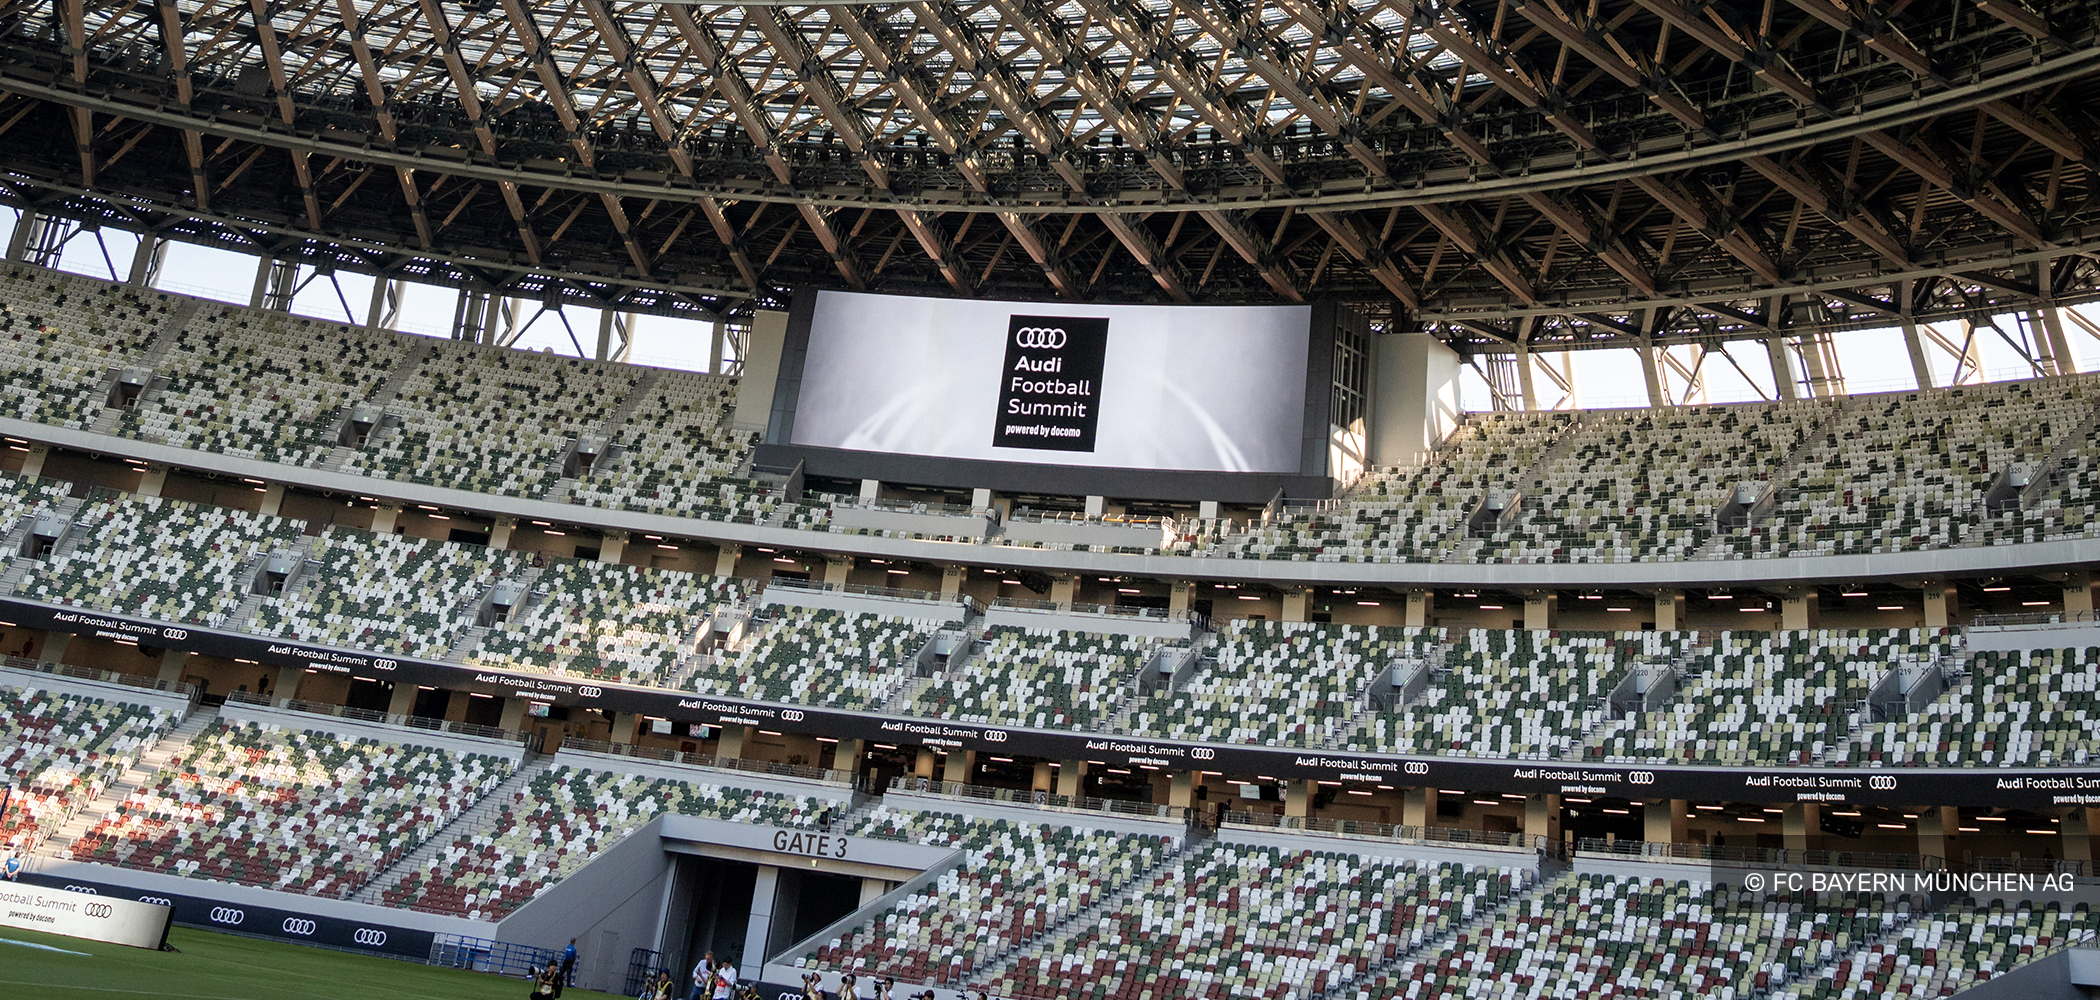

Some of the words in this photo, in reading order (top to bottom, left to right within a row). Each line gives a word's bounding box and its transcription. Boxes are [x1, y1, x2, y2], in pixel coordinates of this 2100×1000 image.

[1014, 356, 1062, 372] Audi
[1011, 377, 1091, 396] Football
[1007, 398, 1087, 417] Summit
[1005, 425, 1039, 435] powered
[1040, 425, 1050, 437] by
[1051, 426, 1081, 437] docomo
[271, 552, 282, 560] 226
[1928, 592, 1940, 600] 219
[2070, 586, 2082, 594] 218
[54, 612, 77, 622] Audi
[79, 616, 117, 629] Football
[119, 622, 158, 635] Summit
[96, 630, 116, 638] powered
[116, 632, 121, 640] by
[122, 634, 139, 642] docomo
[268, 644, 290, 654] Audi
[292, 648, 329, 660] Football
[331, 653, 368, 666] Summit
[309, 662, 328, 670] powered
[334, 665, 350, 673] docomo
[1900, 668, 1912, 676] 219
[475, 673, 497, 683] Audi
[499, 676, 535, 689] Football
[537, 681, 572, 694] Summit
[516, 690, 534, 698] powered
[679, 699, 700, 708] Audi
[702, 702, 738, 714] Football
[740, 706, 775, 717] Summit
[719, 715, 736, 724] powered
[737, 717, 742, 725] by
[743, 718, 759, 726] docomo
[881, 721, 903, 730] Audi
[905, 723, 941, 735] Football
[942, 727, 978, 738] Summit
[923, 737, 940, 745] powered
[941, 738, 946, 746] by
[946, 739, 962, 747] docomo
[1086, 740, 1108, 750] Audi
[1110, 742, 1147, 754] Football
[1148, 746, 1185, 756] Summit
[1129, 756, 1147, 764] powered
[1147, 757, 1152, 765] by
[1153, 758, 1169, 766] docomo
[1295, 756, 1318, 766] Audi
[1320, 758, 1358, 769] Football
[1360, 761, 1398, 772] Summit
[1366, 774, 1382, 782] docomo
[1514, 769, 1537, 779] Audi
[1539, 769, 1580, 781] Football
[1582, 771, 1622, 782] Summit
[1746, 776, 1770, 786] Audi
[1773, 776, 1816, 788] Football
[1819, 777, 1862, 788] Summit
[1996, 778, 2023, 789] Audi
[2026, 778, 2074, 789] Football
[2076, 777, 2100, 789] Sum
[1561, 785, 1581, 793] powered
[1581, 786, 1587, 794] by
[1588, 786, 1606, 794] docomo
[1797, 792, 1818, 801] powered
[1819, 792, 1825, 802] by
[1826, 793, 1845, 801] docomo
[2053, 794, 2076, 804] powered
[2077, 794, 2084, 804] by
[774, 830, 830, 856] GATE
[835, 838, 848, 858] 3
[0, 892, 33, 905] ootball
[35, 896, 78, 912] Summit
[8, 910, 30, 920] powered
[30, 912, 36, 922] by
[36, 914, 55, 923] docomo
